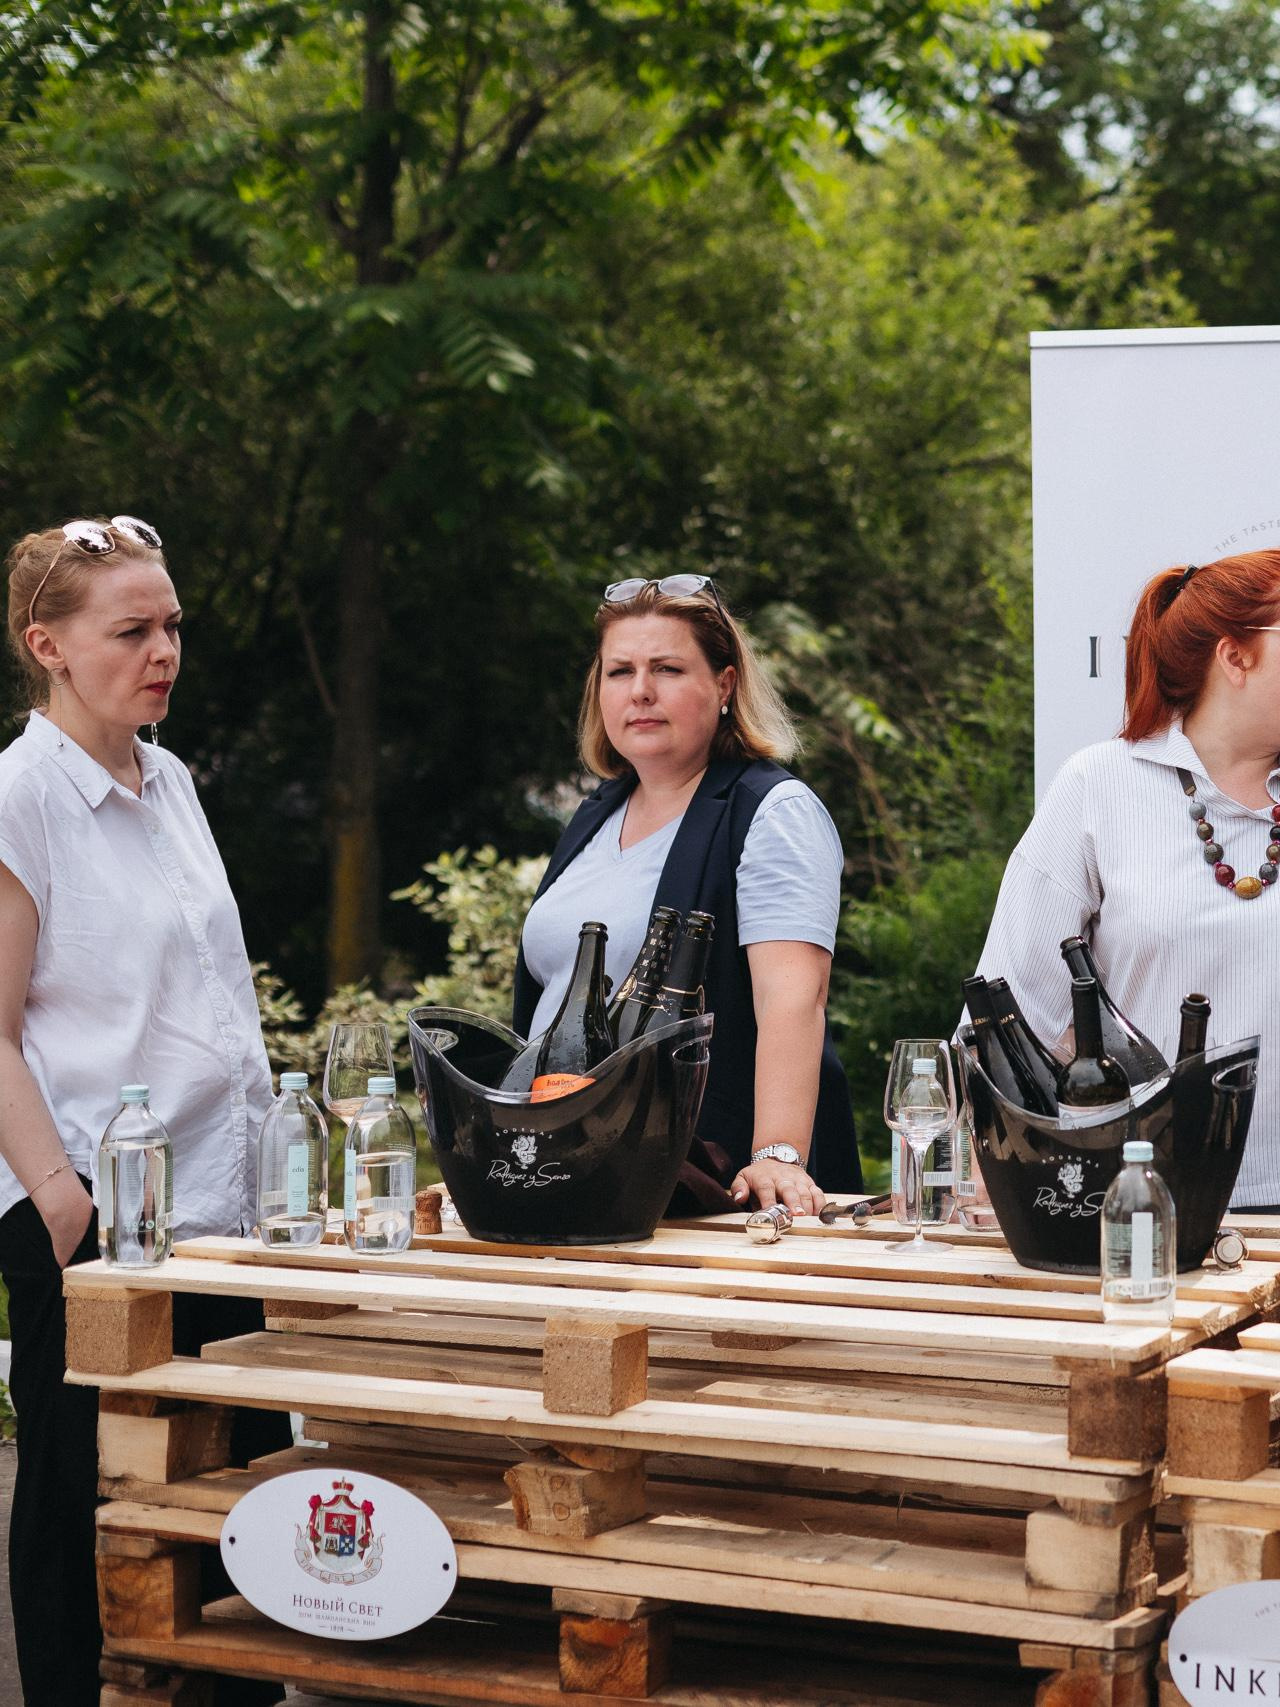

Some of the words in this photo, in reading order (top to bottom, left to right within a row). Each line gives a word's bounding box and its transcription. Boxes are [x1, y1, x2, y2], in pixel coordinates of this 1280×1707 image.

[1214, 534, 1238, 553] THE
[496, 1127, 552, 1139] BODEGAS
[348, 1601, 383, 1617] СВЕТ
